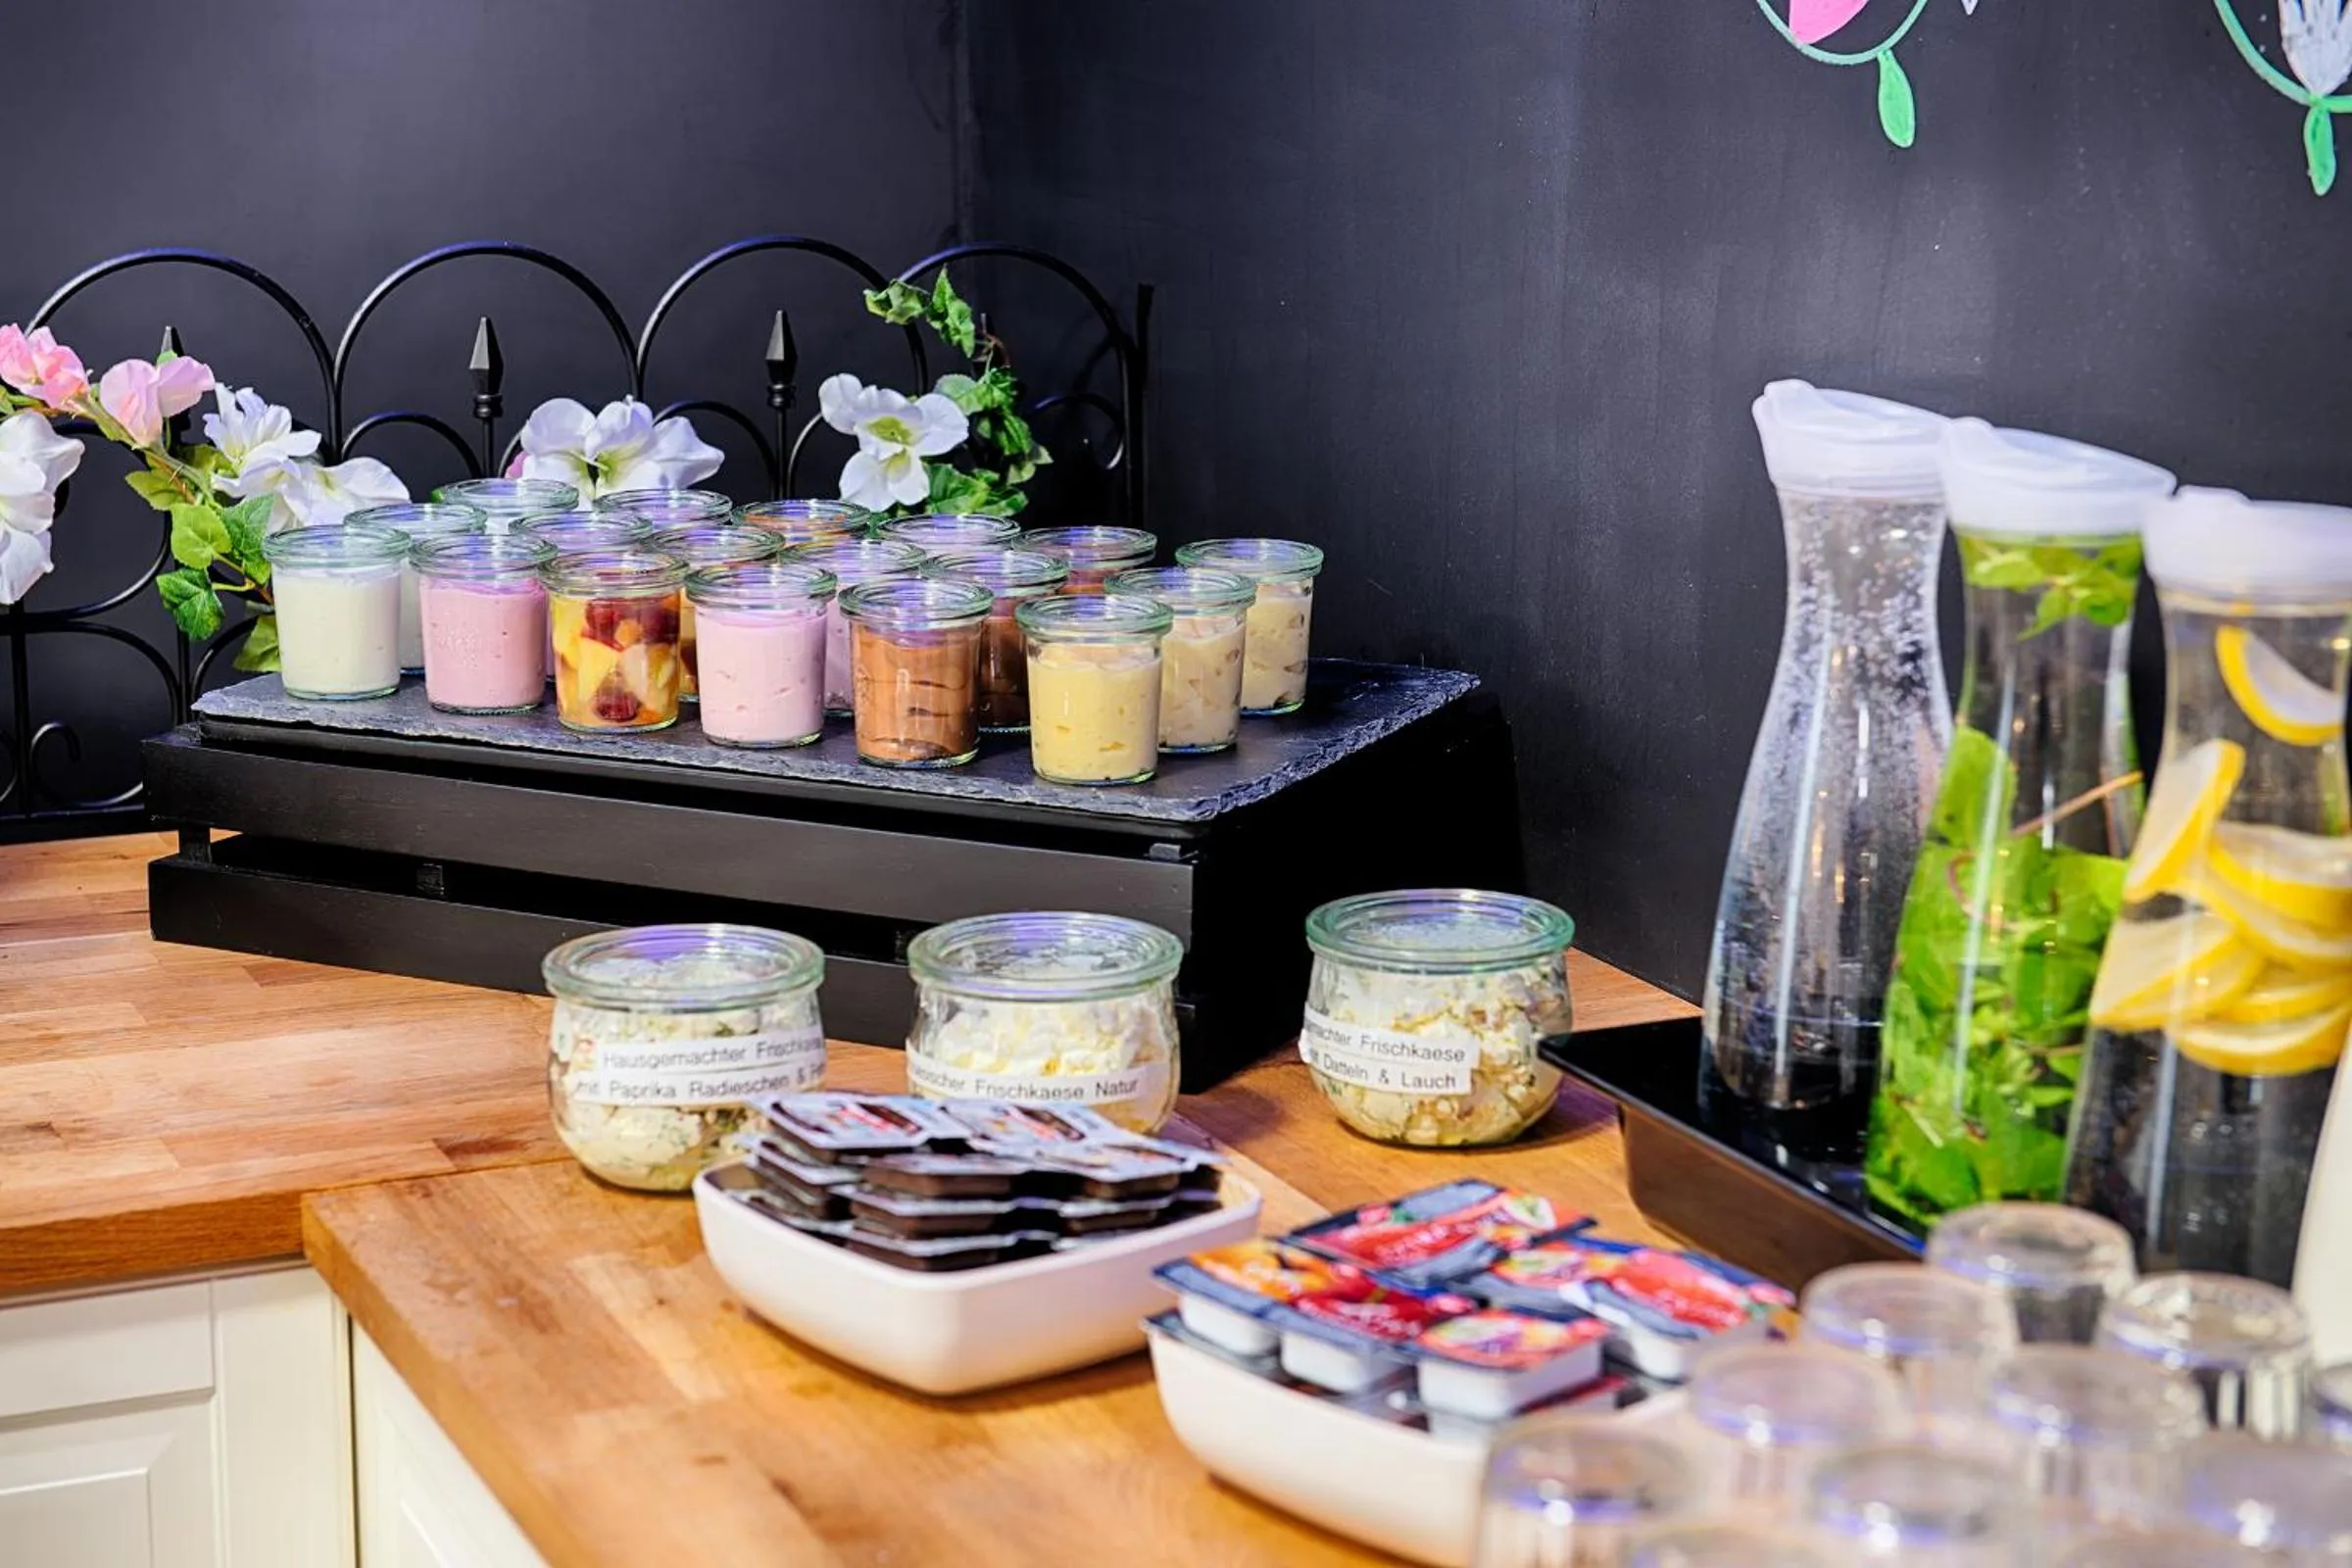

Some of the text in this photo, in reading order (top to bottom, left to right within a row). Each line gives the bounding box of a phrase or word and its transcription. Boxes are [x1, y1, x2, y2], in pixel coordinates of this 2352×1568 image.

[603, 1046, 748, 1070] Hausgemachter
[1359, 1035, 1466, 1062] Frischkaese
[1323, 1053, 1368, 1081] Datteln
[1378, 1068, 1390, 1085] &
[1400, 1071, 1456, 1090] Lauch
[609, 1079, 677, 1100] Paprika
[689, 1072, 790, 1099] Radieschen
[975, 1080, 1085, 1101] Frischkaese
[1095, 1077, 1139, 1097] Natur
